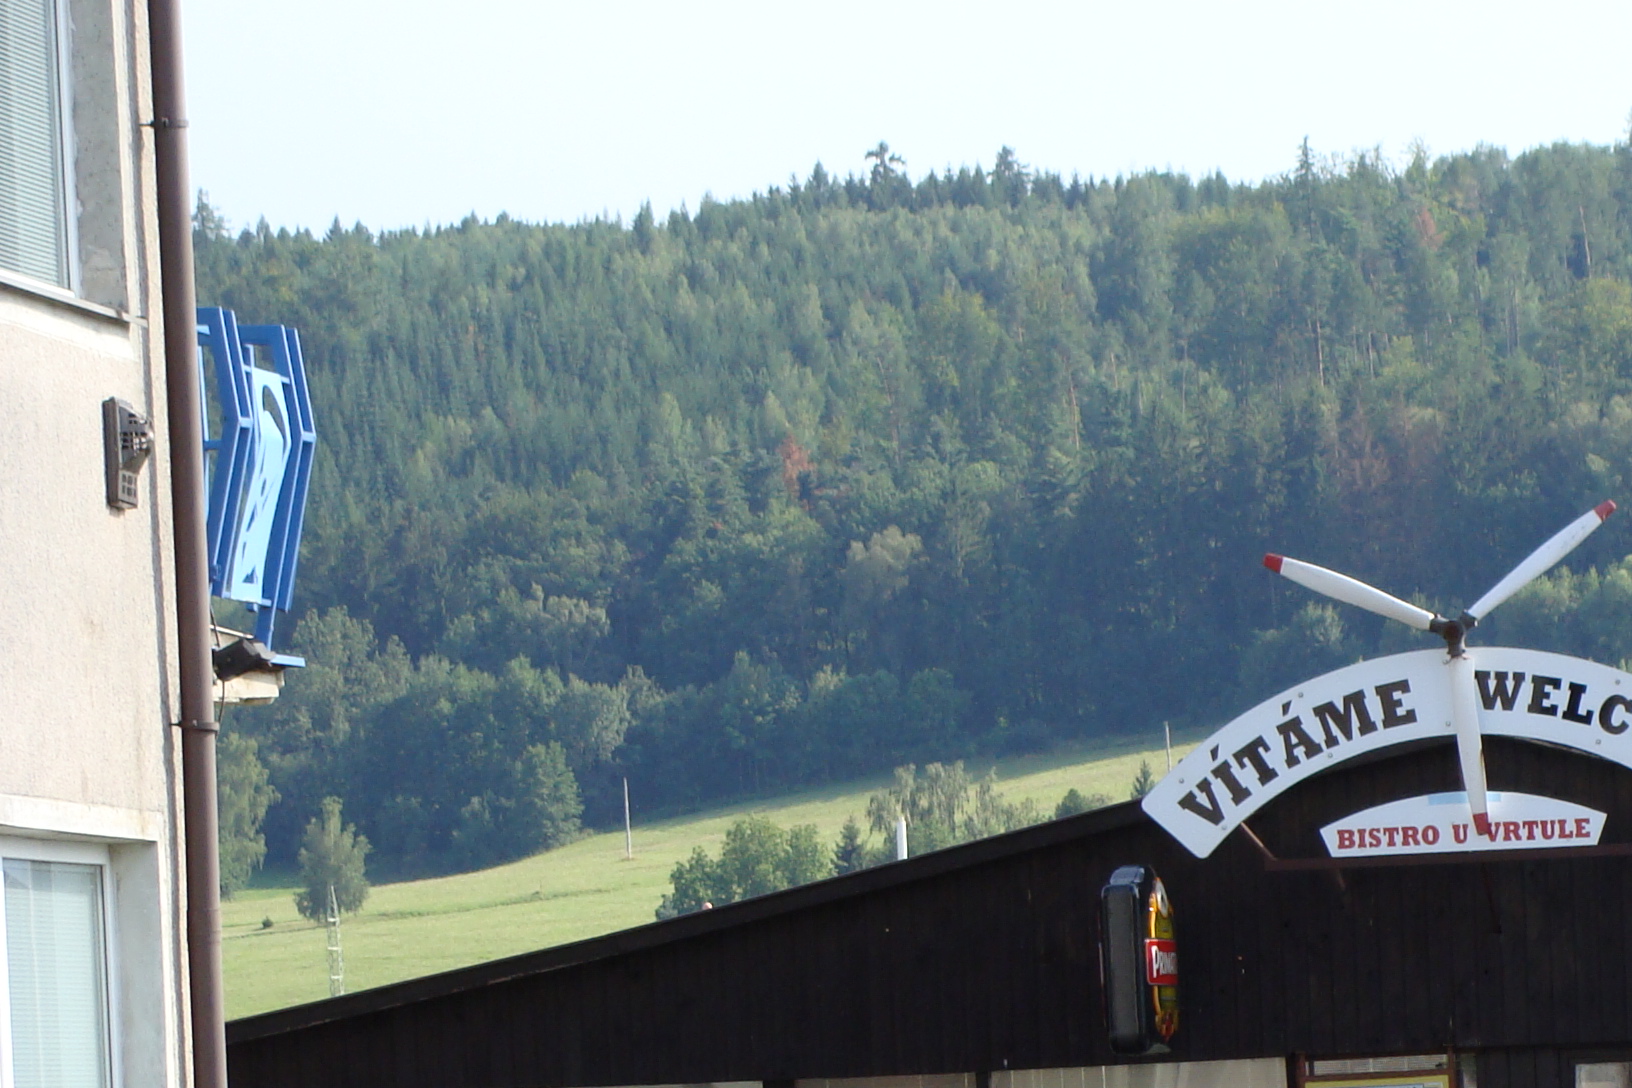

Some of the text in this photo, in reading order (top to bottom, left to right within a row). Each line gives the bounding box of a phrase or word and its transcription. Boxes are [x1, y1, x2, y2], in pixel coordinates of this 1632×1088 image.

[1177, 678, 1419, 828] VÍTÁME
[1336, 817, 1592, 850] BISTRO U VRTULE
